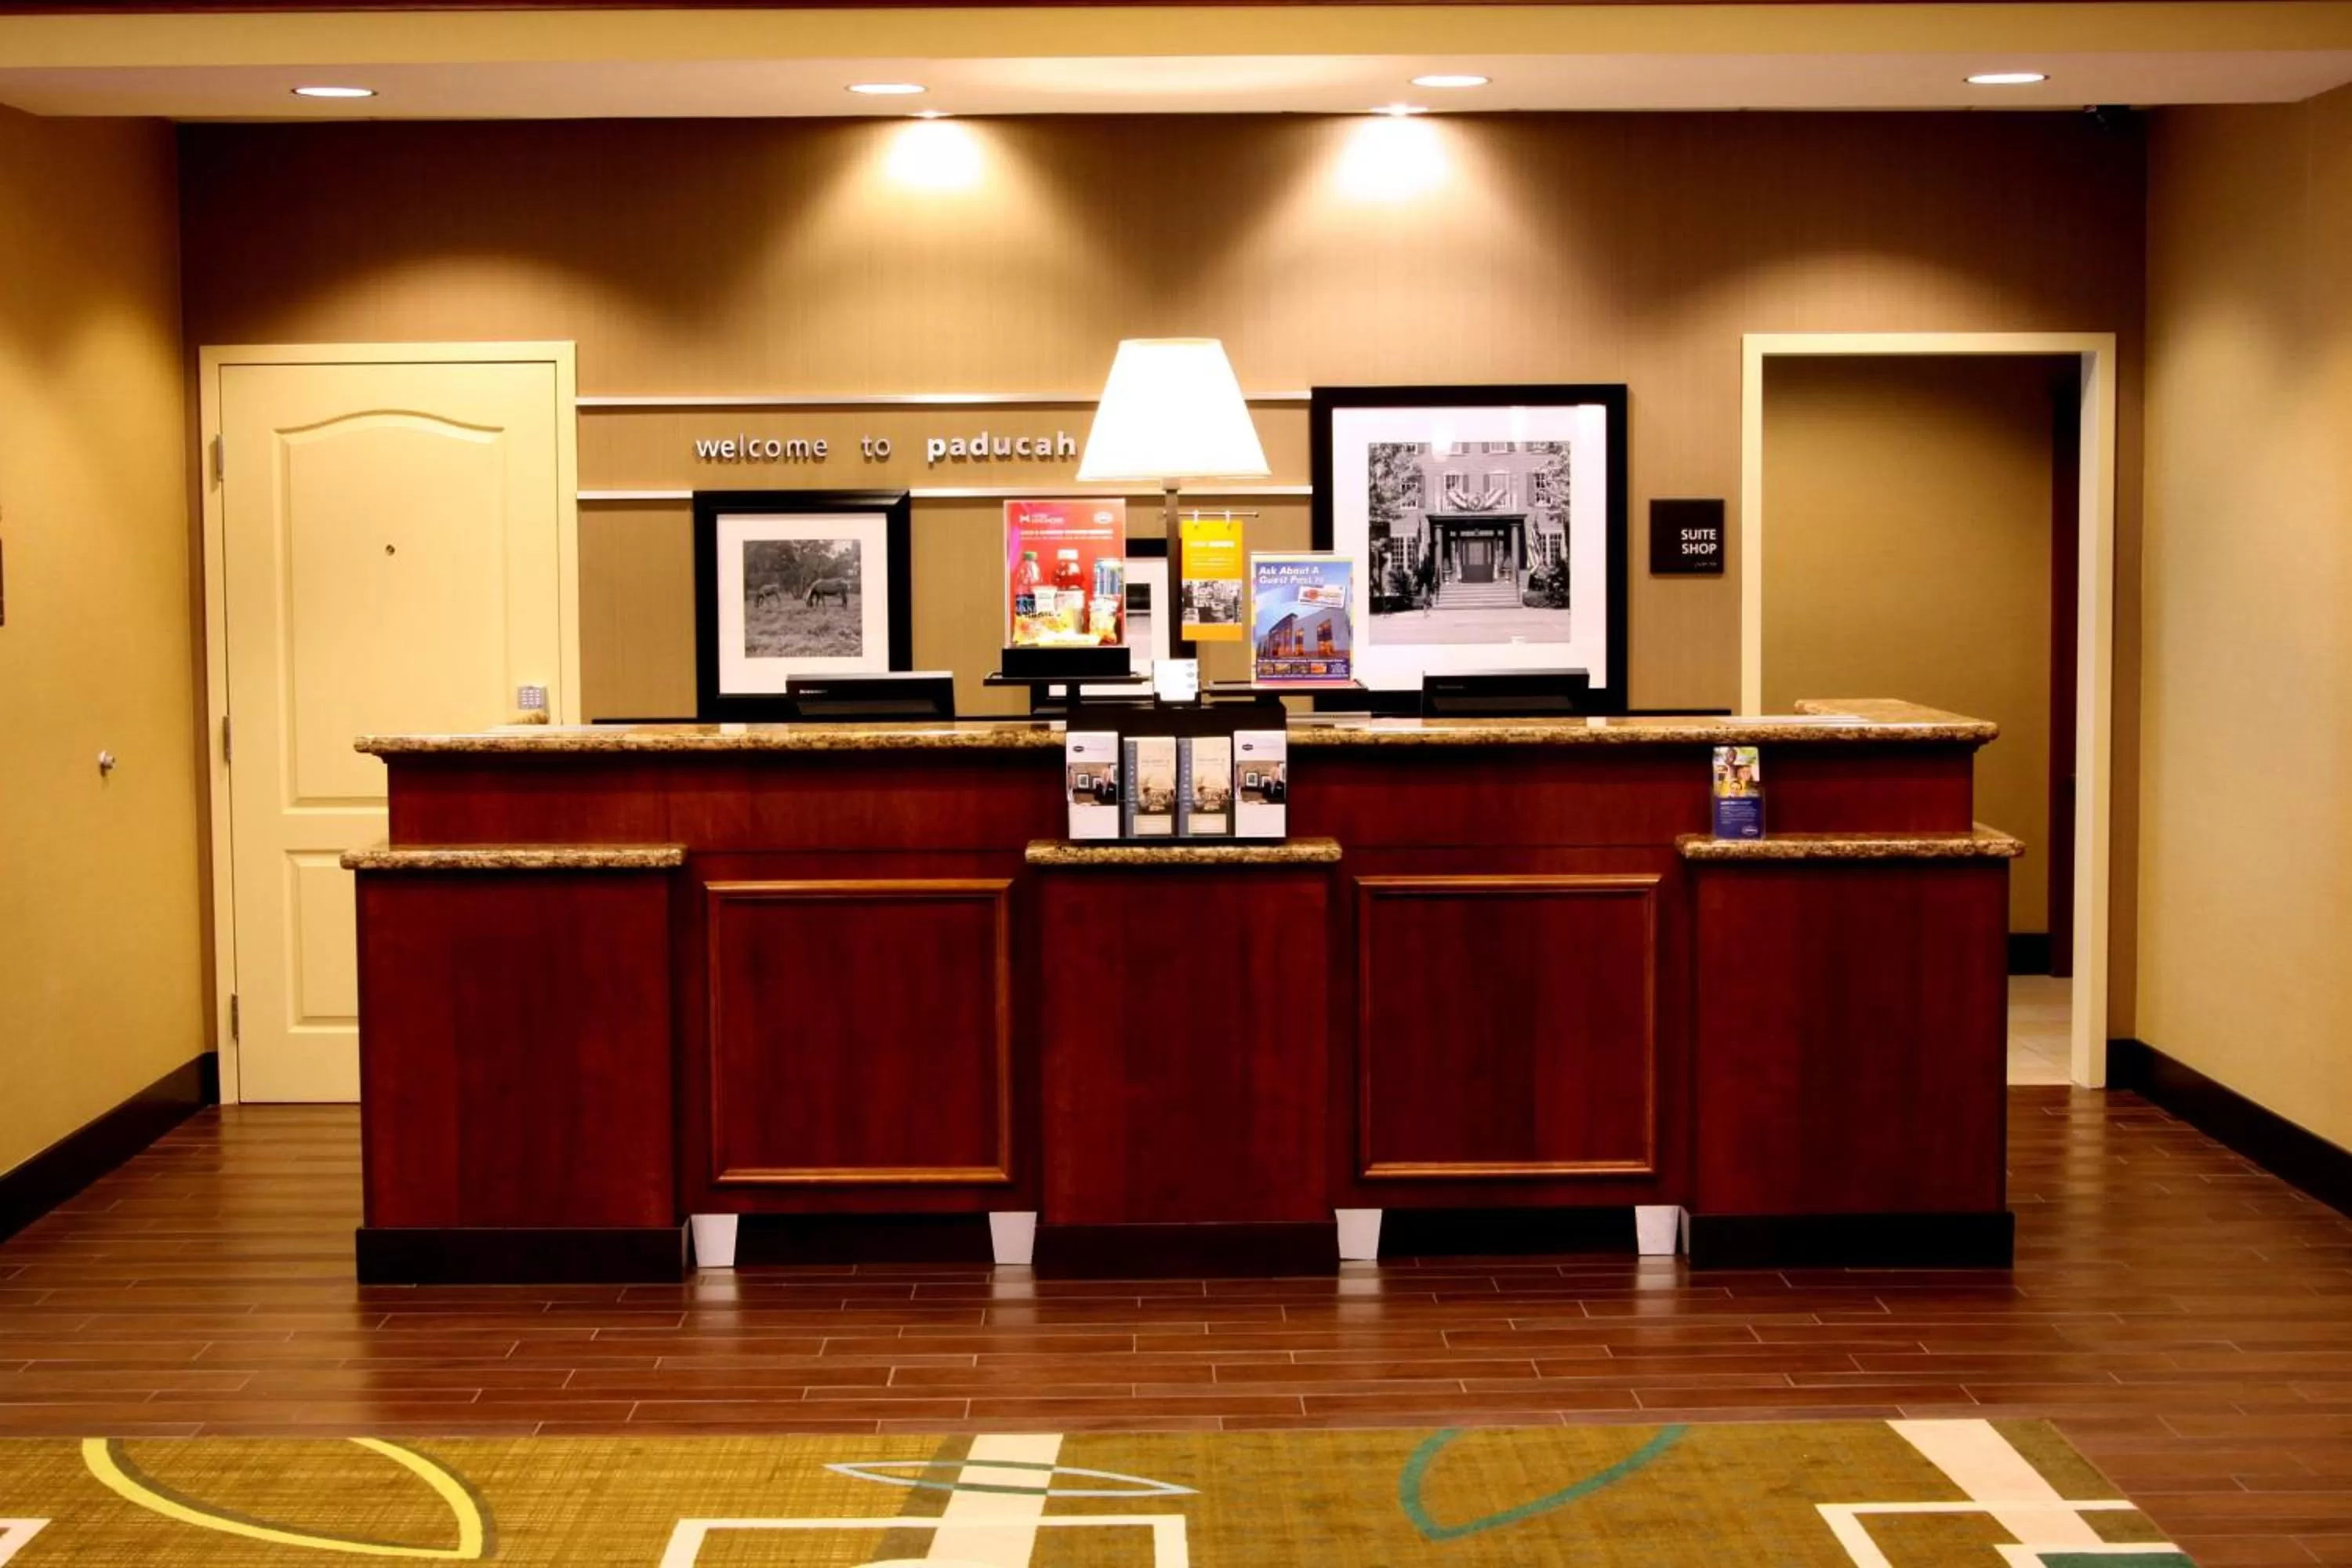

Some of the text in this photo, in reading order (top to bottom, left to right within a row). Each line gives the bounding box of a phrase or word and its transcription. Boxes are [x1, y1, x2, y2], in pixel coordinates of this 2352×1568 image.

[695, 430, 1077, 463] welcome to paducah
[1680, 528, 1717, 541] SUITE
[1681, 543, 1718, 555] SHOP
[1258, 565, 1320, 575] Ask About A
